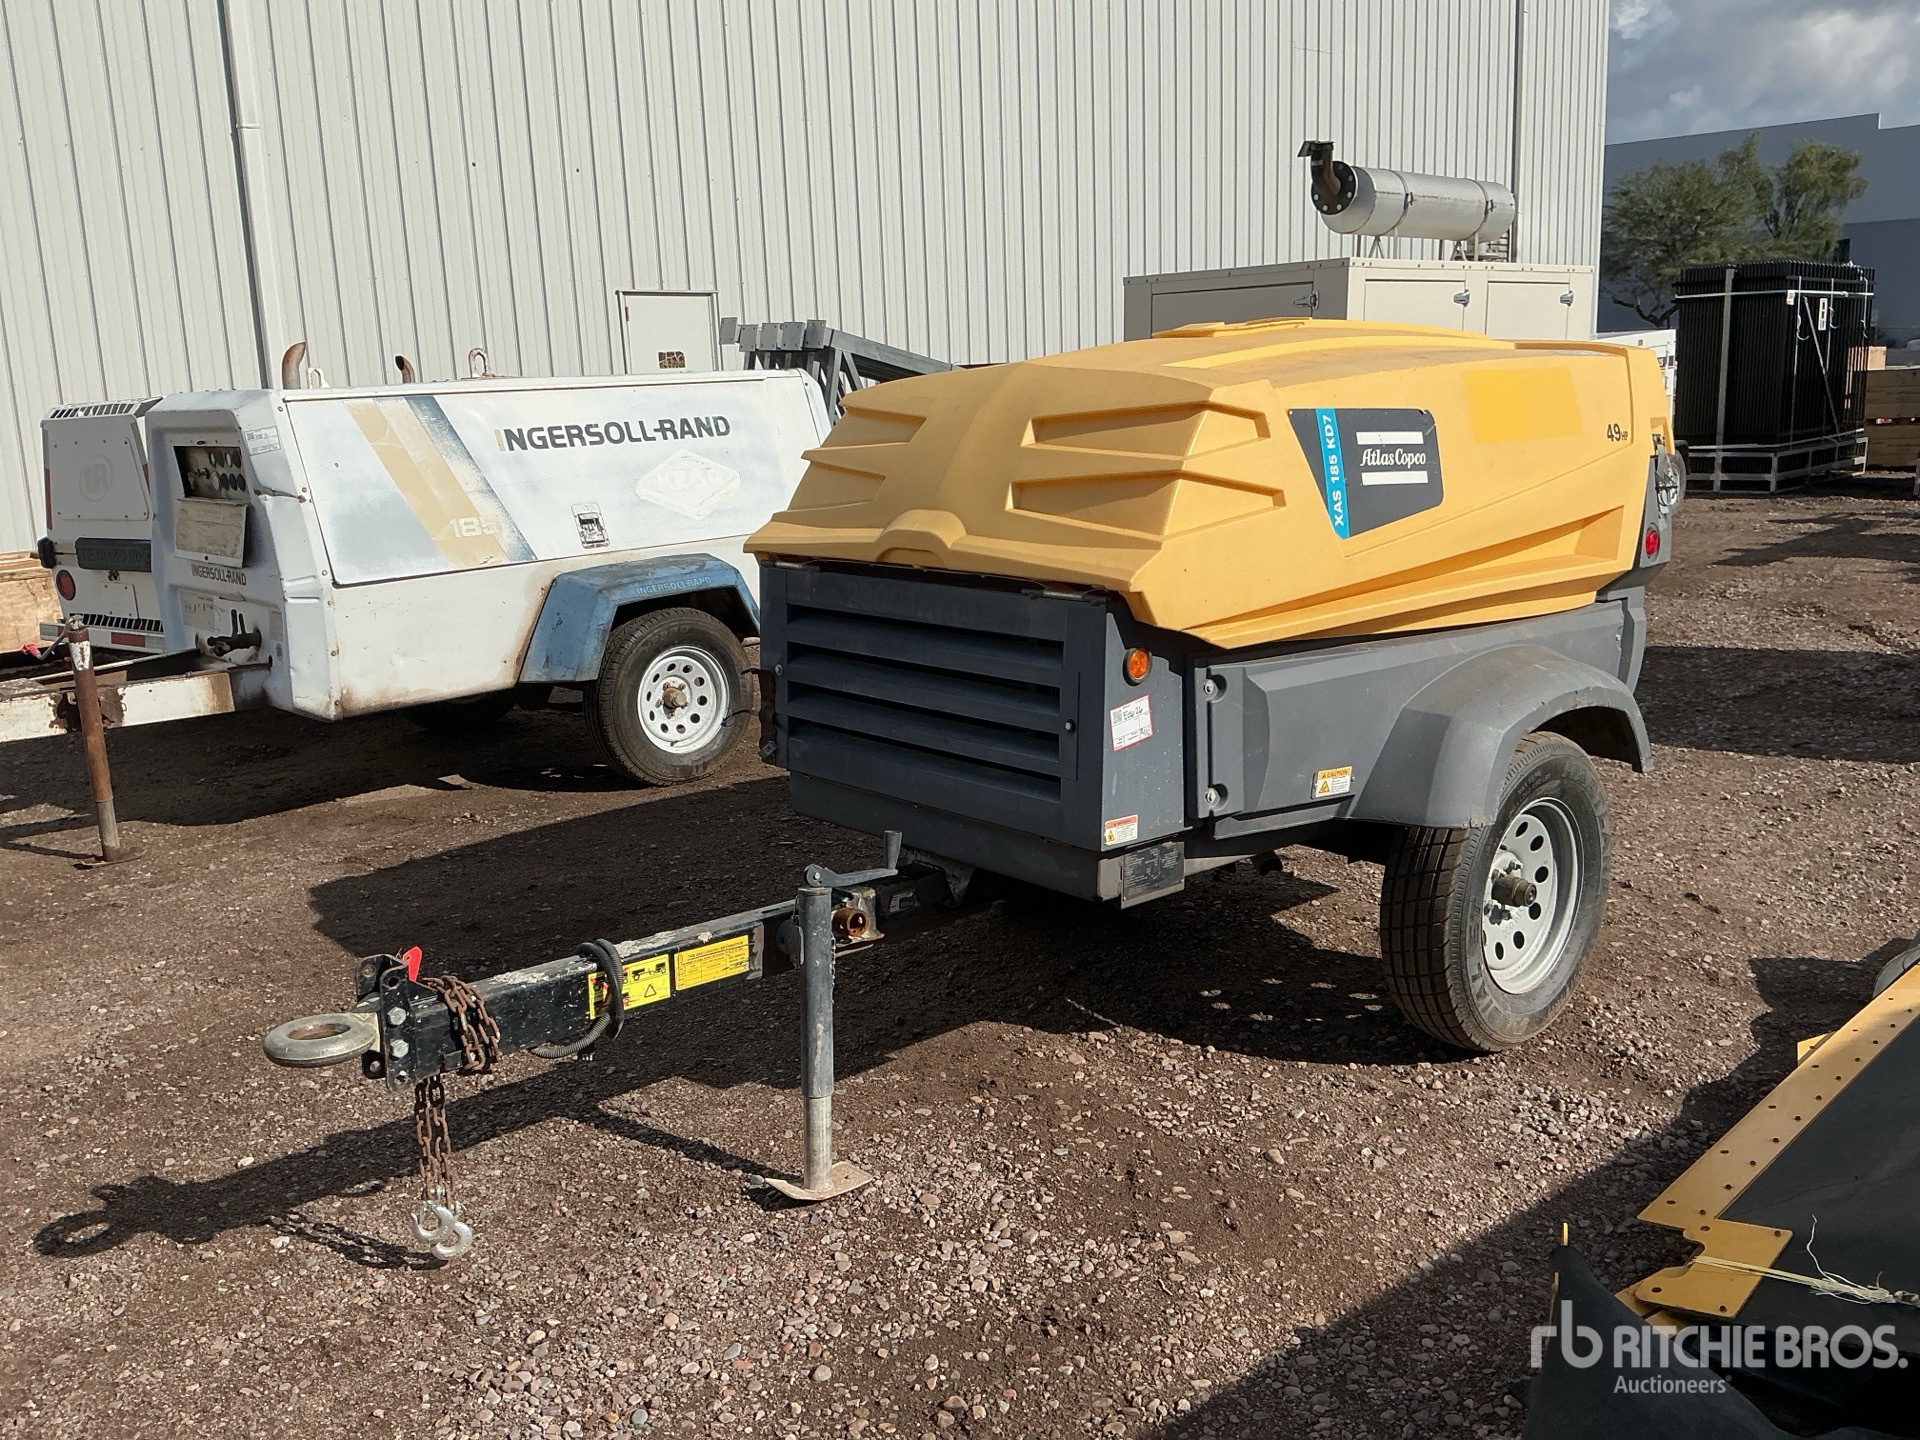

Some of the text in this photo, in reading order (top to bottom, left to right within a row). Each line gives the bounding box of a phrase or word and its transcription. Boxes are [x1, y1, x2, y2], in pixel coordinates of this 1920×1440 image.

[495, 415, 730, 452] INGERSOLL-RAND
[1360, 447, 1427, 469] Atlas Copco
[1322, 414, 1345, 527] XAS 185 KD7
[191, 563, 247, 586] INGERSOLL-RAND
[636, 576, 711, 595] INGERSOLL-RAND
